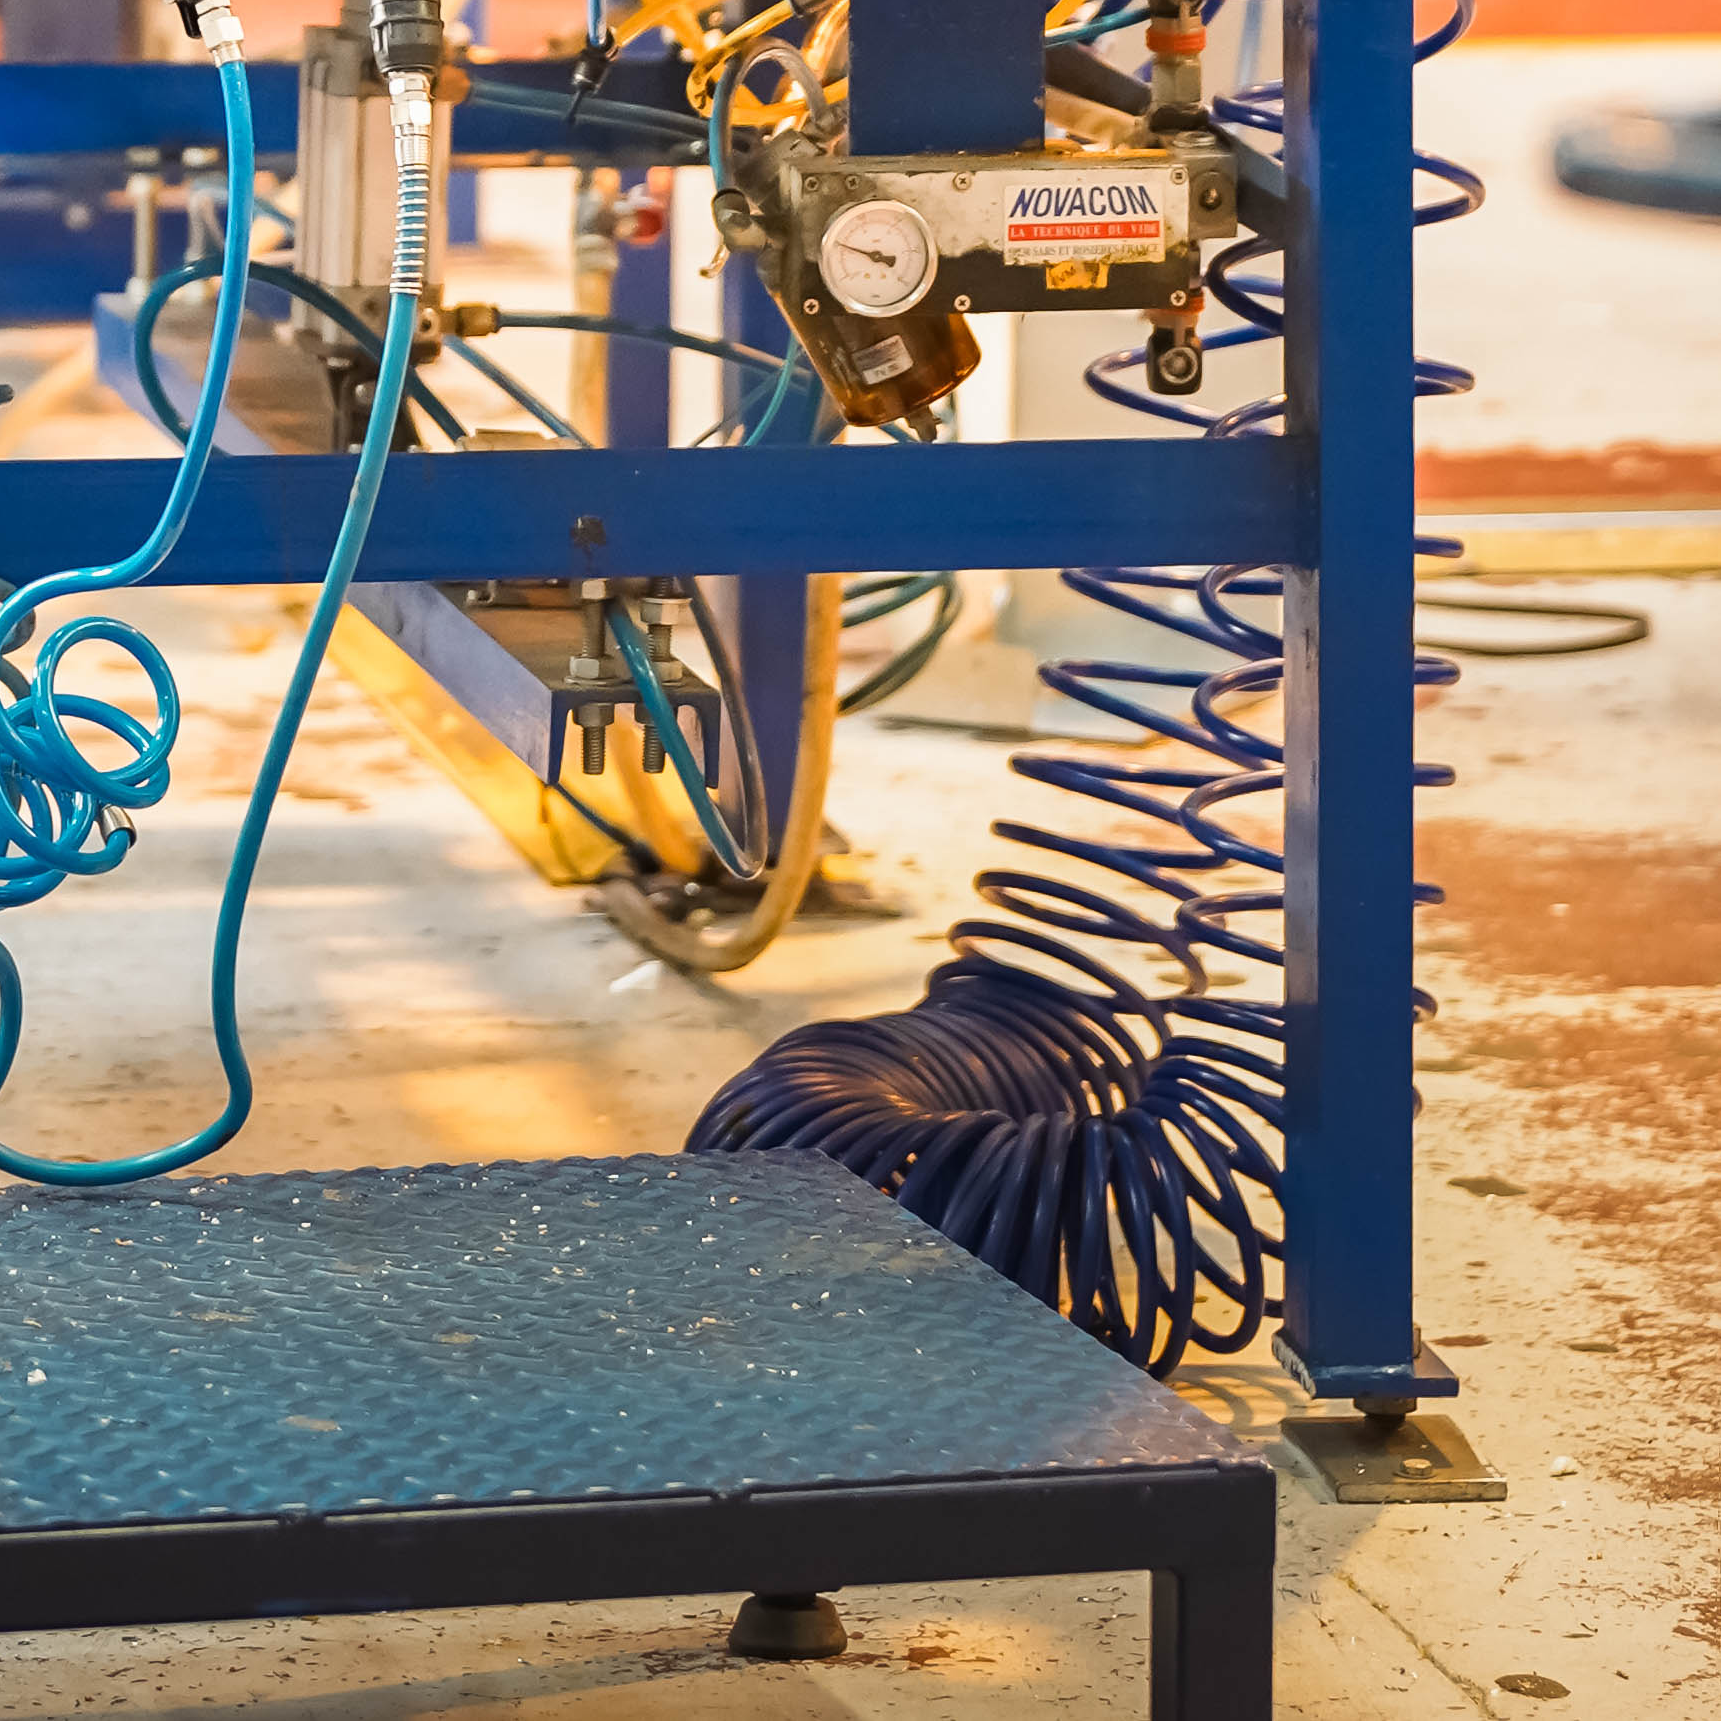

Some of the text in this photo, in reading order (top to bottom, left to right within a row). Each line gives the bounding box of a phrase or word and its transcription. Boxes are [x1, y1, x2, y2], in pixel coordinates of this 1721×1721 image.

[1009, 185, 1158, 218] NOVACOM
[1010, 226, 1025, 238] LA
[1033, 225, 1102, 237] TECHNIQUE
[1130, 223, 1159, 234] VIDE
